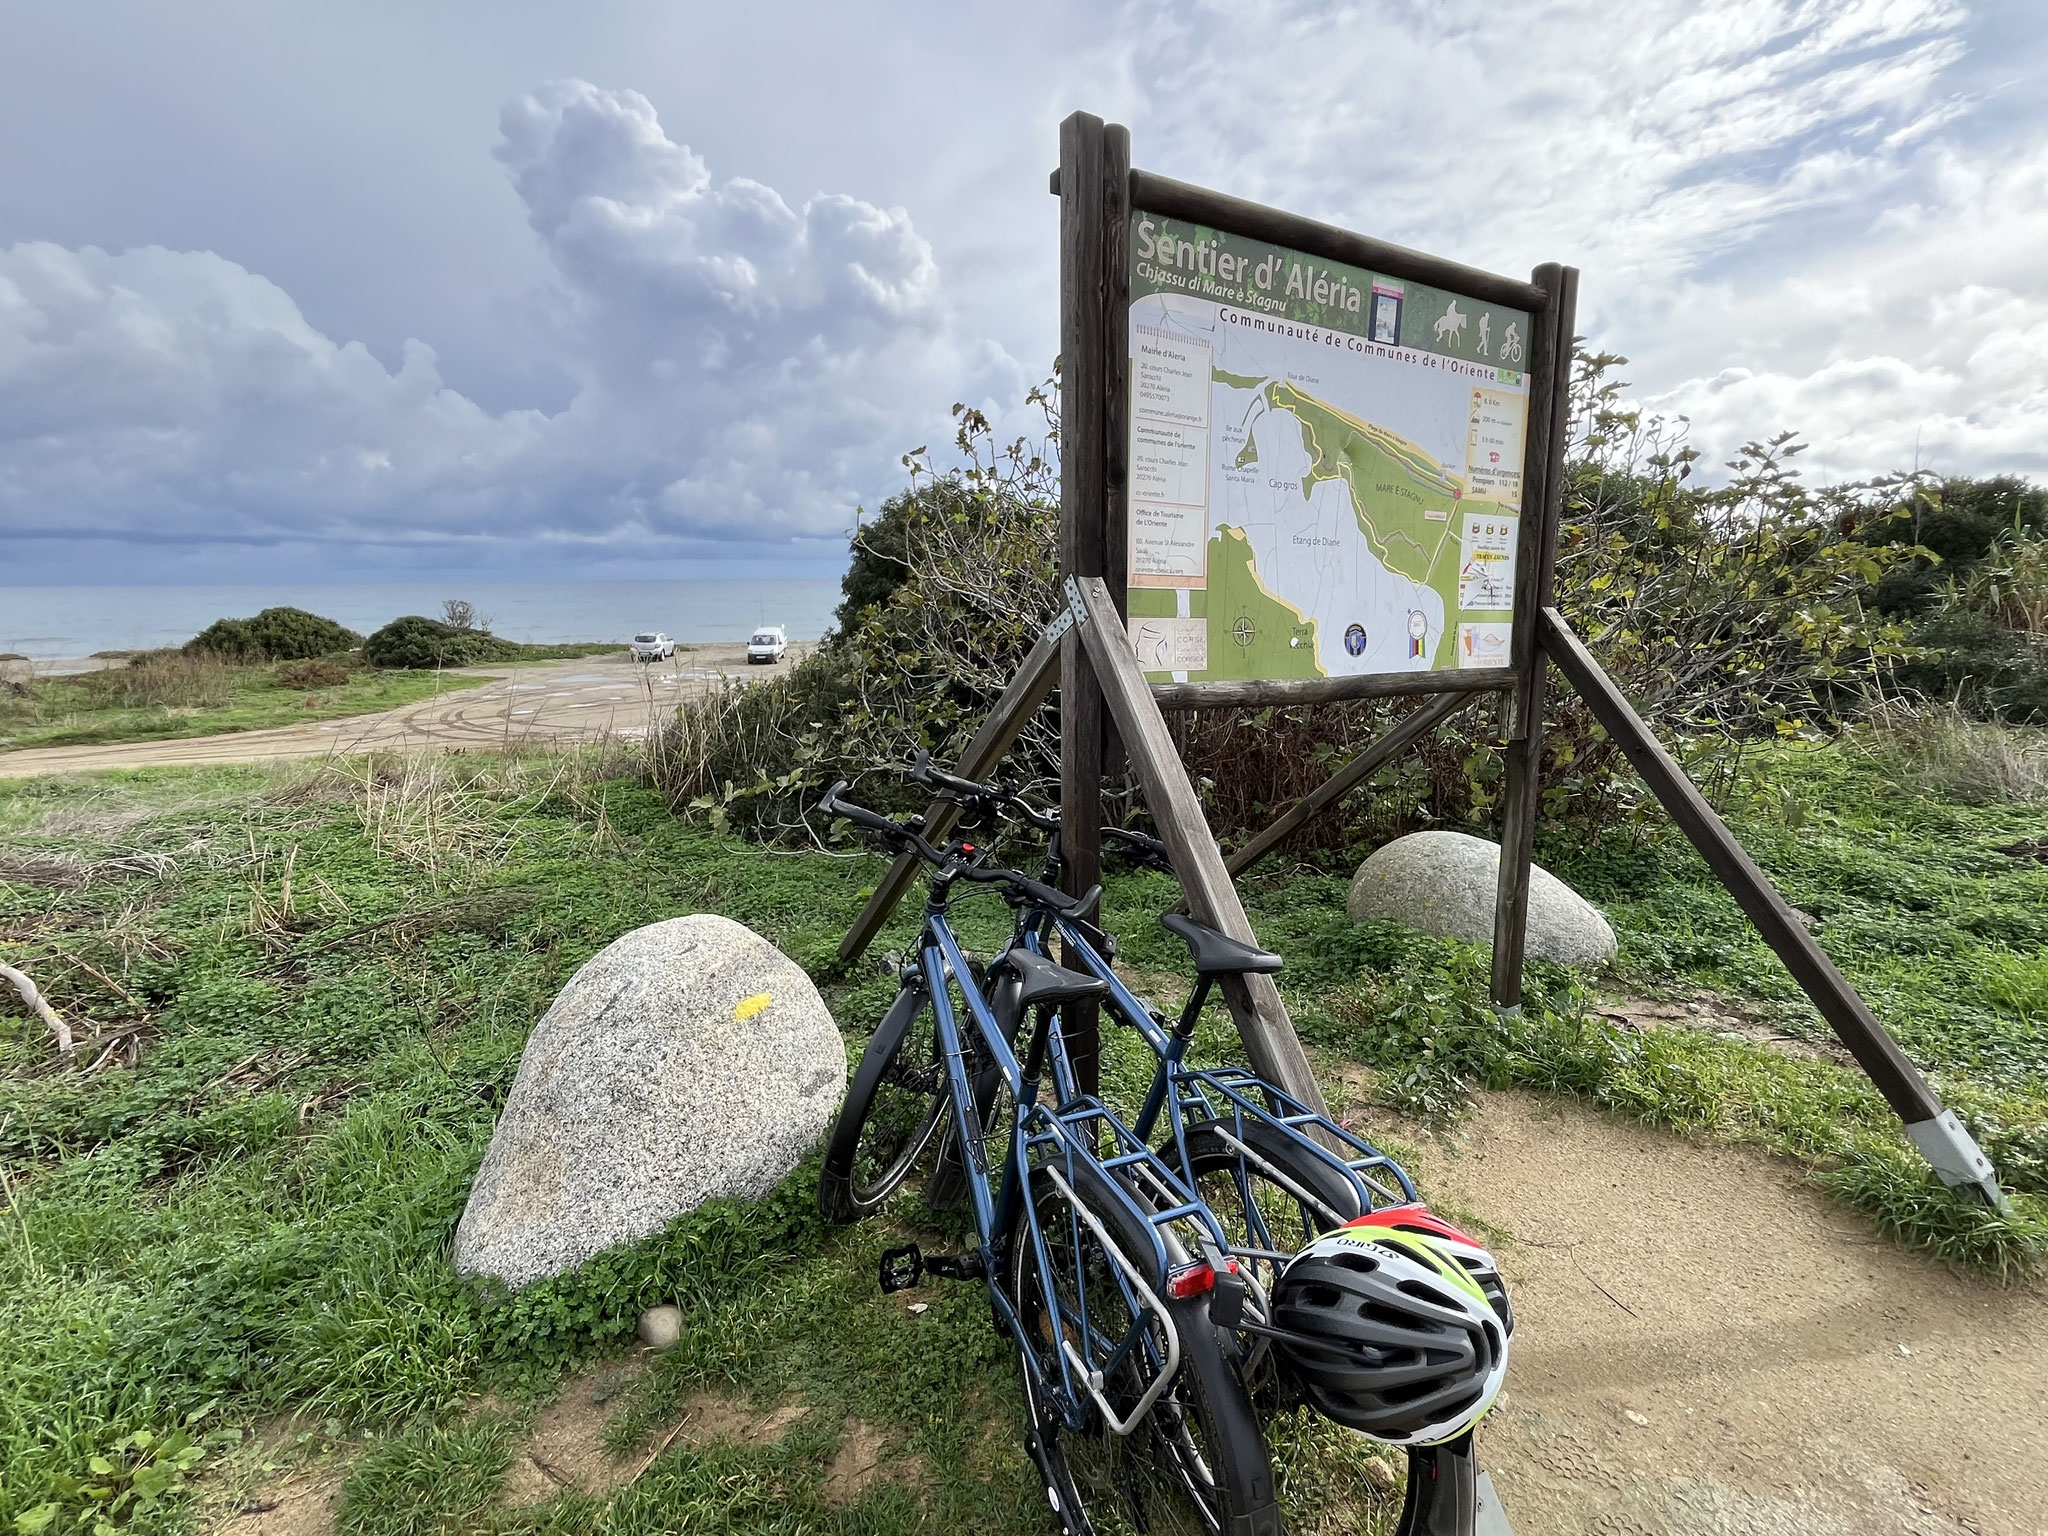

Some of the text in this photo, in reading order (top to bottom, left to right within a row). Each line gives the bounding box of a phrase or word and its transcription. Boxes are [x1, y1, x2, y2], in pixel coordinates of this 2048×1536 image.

[1137, 220, 1249, 283] Sentier
[1285, 263, 1361, 313] Aléria
[1136, 262, 1187, 287] Chjassu
[1188, 276, 1201, 291] di
[1202, 280, 1235, 299] Mare
[1245, 290, 1287, 312] Stagnu
[1219, 308, 1319, 343] Communauté
[1325, 333, 1341, 348] de
[1347, 338, 1417, 364] Communes
[1422, 355, 1437, 368] de
[1141, 345, 1162, 356] Mairie
[1163, 366, 1181, 376] Charles
[1136, 425, 1173, 437] Communauté
[1136, 437, 1166, 446] communes
[1225, 474, 1240, 482] Santa
[1268, 478, 1298, 492] Cap gros
[1375, 483, 1394, 494] MARE
[1400, 487, 1425, 506] STAGNU
[1312, 536, 1321, 546] de
[1322, 536, 1341, 547] Diane
[1292, 627, 1309, 636] Terra
[1337, 1238, 1378, 1252] GIRO
